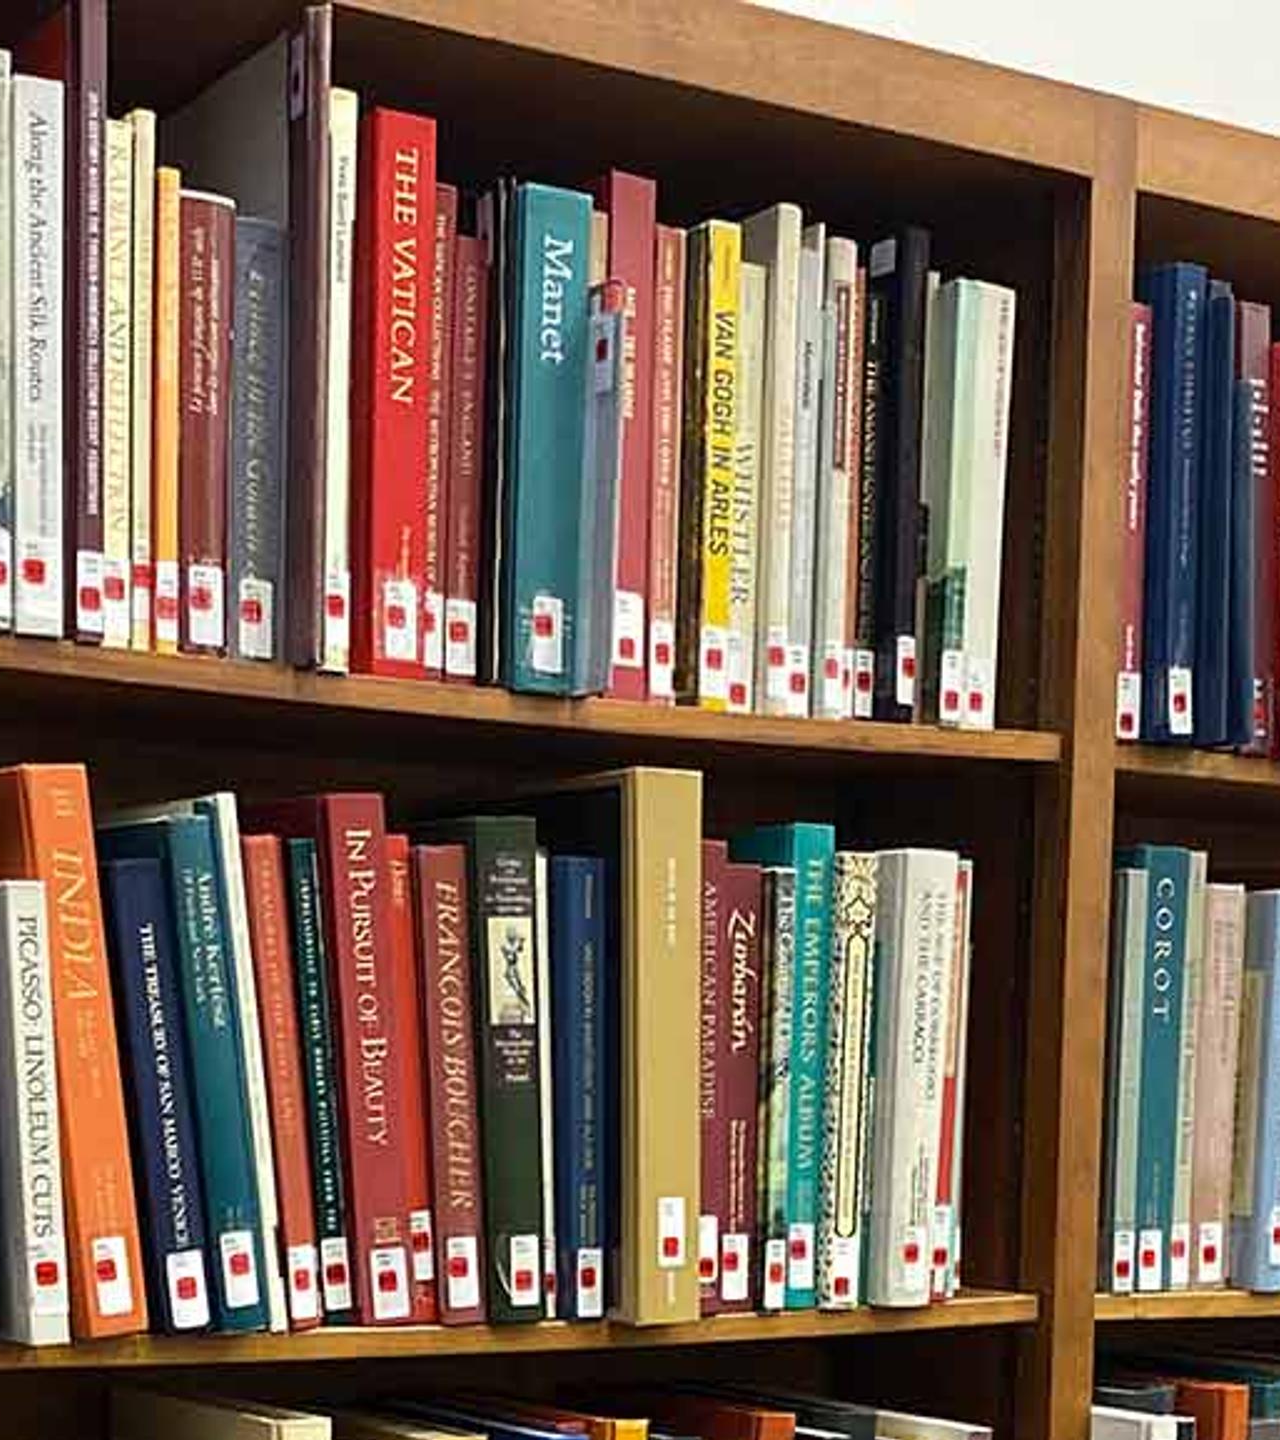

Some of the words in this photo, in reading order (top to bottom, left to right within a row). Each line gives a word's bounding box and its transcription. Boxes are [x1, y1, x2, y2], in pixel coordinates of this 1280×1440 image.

[25, 111, 48, 171] Along
[29, 177, 47, 206] the
[393, 148, 420, 224] THE
[29, 212, 47, 289] Ancient
[29, 295, 47, 329] Silk
[110, 298, 130, 363] AND
[389, 238, 418, 404] VATICAN
[539, 234, 574, 365] Manet
[713, 311, 735, 359] VAN
[29, 336, 47, 401] Routes
[712, 368, 734, 435] GOGH
[711, 445, 732, 469] IN
[710, 479, 732, 554] ARLES
[732, 441, 755, 603] WHISTLER
[345, 827, 374, 860] IN
[805, 856, 824, 906] THE
[918, 891, 933, 931] AND
[51, 847, 99, 1002] INDIA
[139, 924, 156, 959] THE
[348, 869, 383, 987] PURSUIT
[702, 880, 718, 1005] AMERICAN
[916, 936, 931, 969] THE
[1153, 877, 1176, 1023] COROT
[18, 916, 41, 1025] PICASSO:
[726, 906, 758, 1052] Zurbarán
[143, 963, 165, 1050] TREASURY
[357, 993, 379, 1031] OF
[25, 1034, 49, 1163] LINOLEUM
[157, 1081, 173, 1113] SAN
[360, 1036, 395, 1147] BEAUTY
[701, 1013, 717, 1118] PARADISE
[162, 1117, 181, 1177] MARCO
[443, 1051, 475, 1208] BOUCHER
[797, 1073, 817, 1168] ALBUM
[32, 1172, 54, 1236] CUTS
[169, 1183, 189, 1247] VENICE
